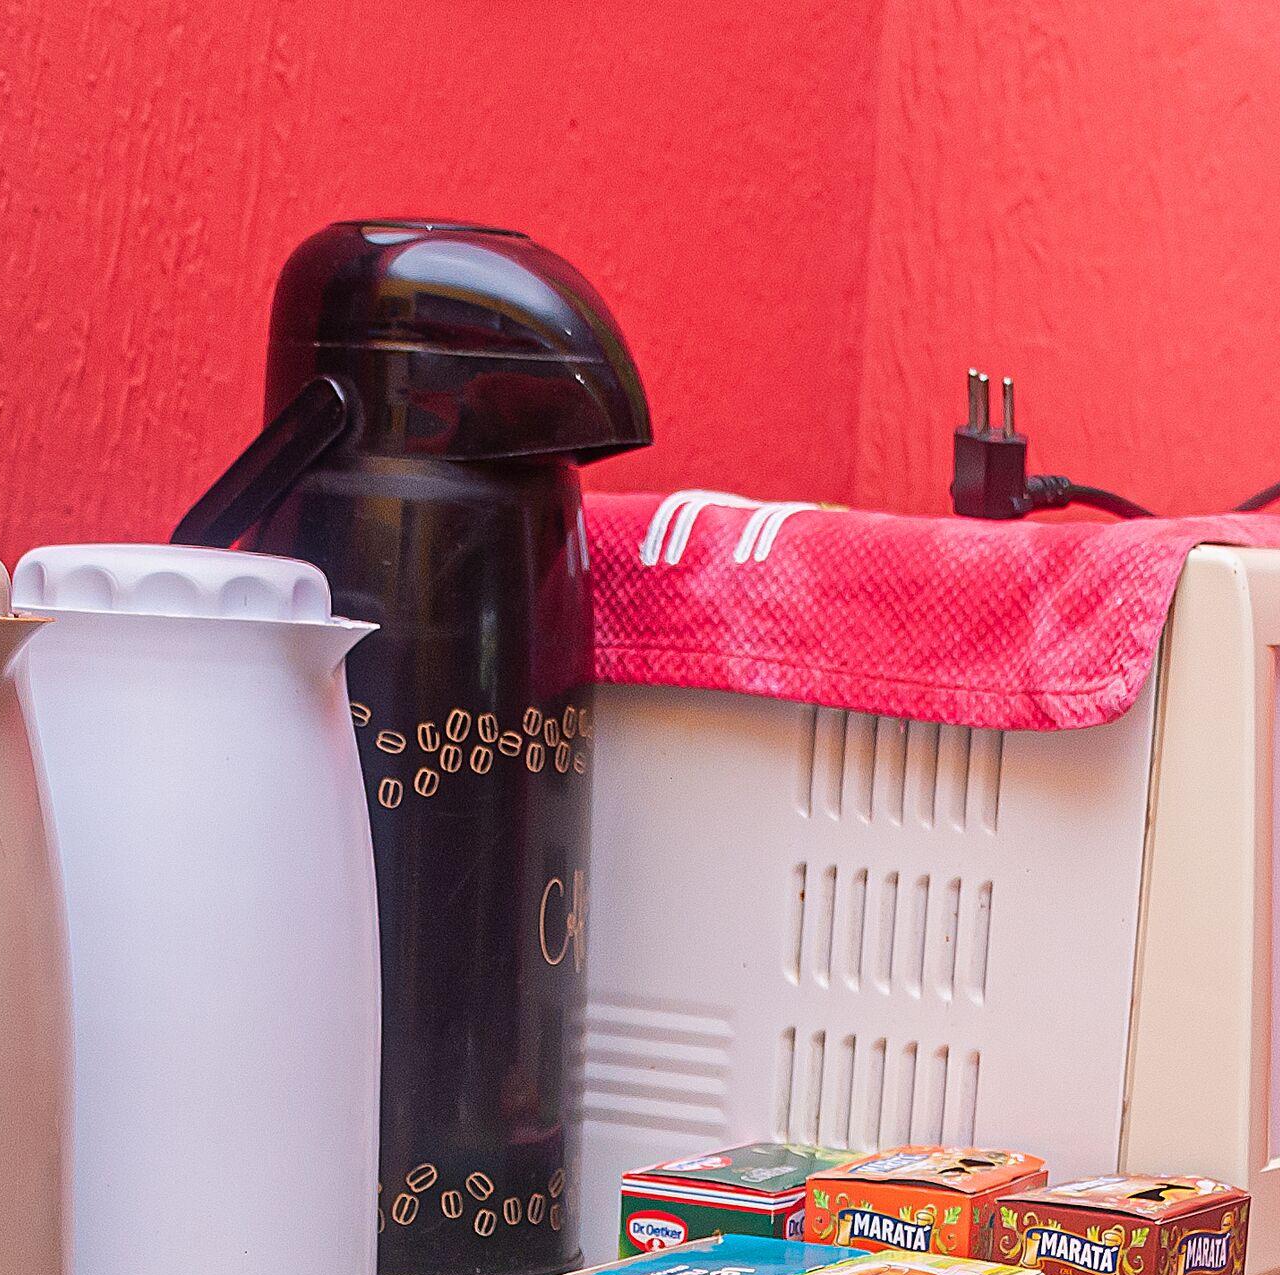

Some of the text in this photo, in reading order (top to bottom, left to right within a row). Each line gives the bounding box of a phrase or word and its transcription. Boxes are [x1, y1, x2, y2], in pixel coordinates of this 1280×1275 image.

[854, 1212, 930, 1251] MARATÁ
[1186, 1233, 1231, 1269] MARATÁ
[1040, 1231, 1119, 1272] MARATÁ
